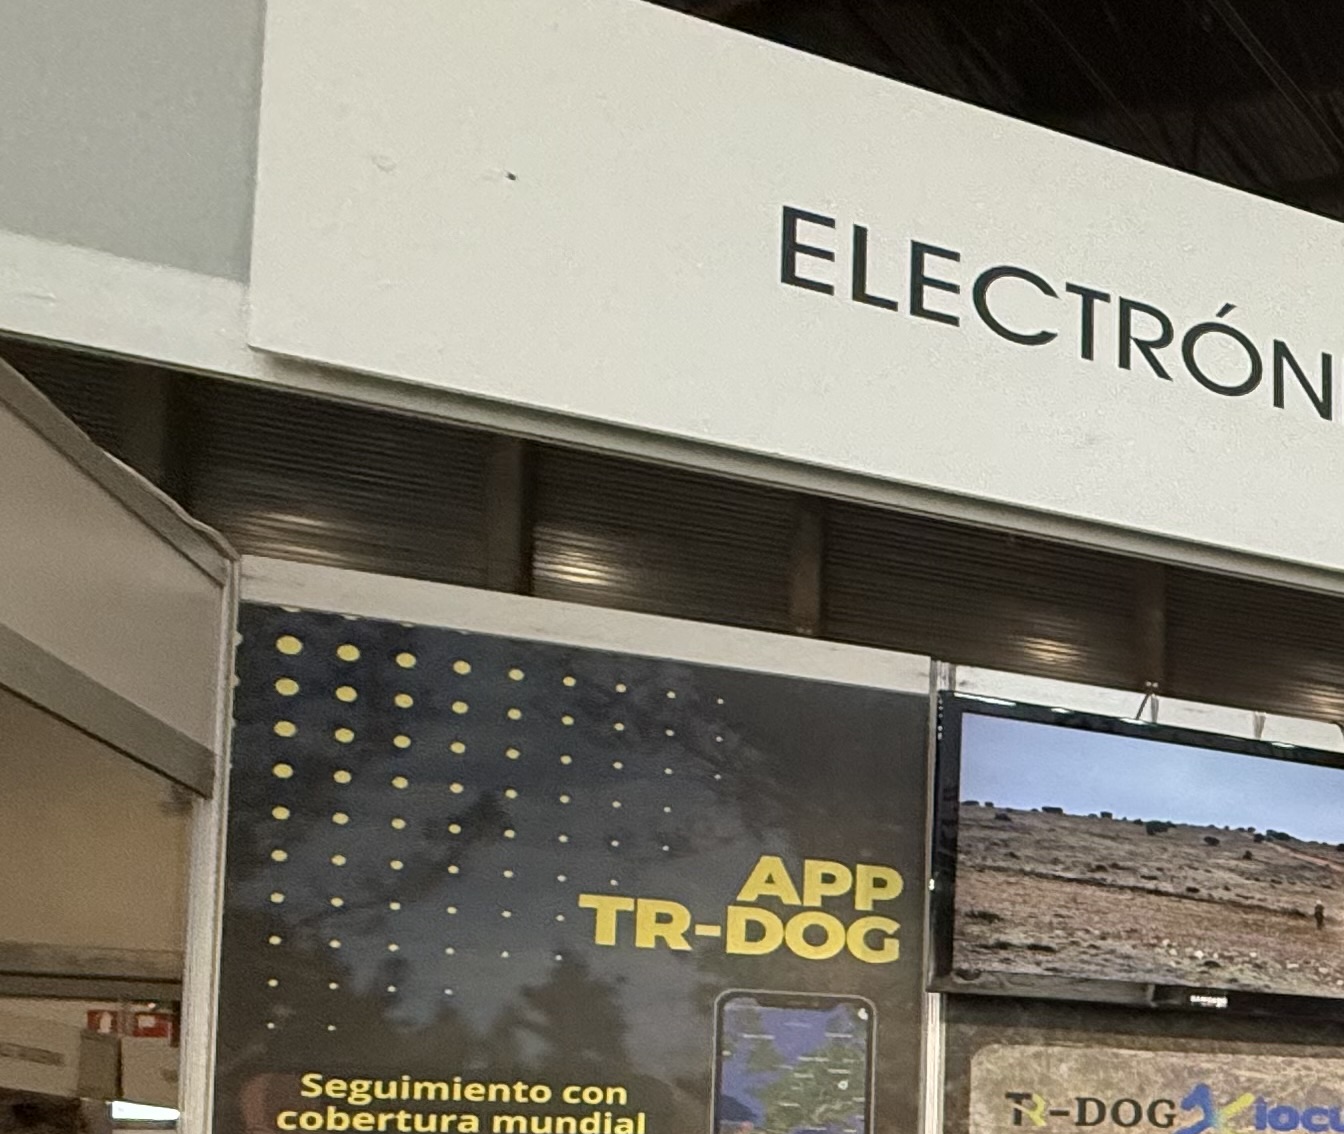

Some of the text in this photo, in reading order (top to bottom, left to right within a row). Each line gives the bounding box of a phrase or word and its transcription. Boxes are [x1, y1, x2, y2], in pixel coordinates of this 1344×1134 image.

[738, 855, 903, 912] APP
[579, 893, 903, 964] TR-DOG
[300, 1072, 628, 1113] Seguimiento con
[276, 1107, 480, 1134] cobertura
